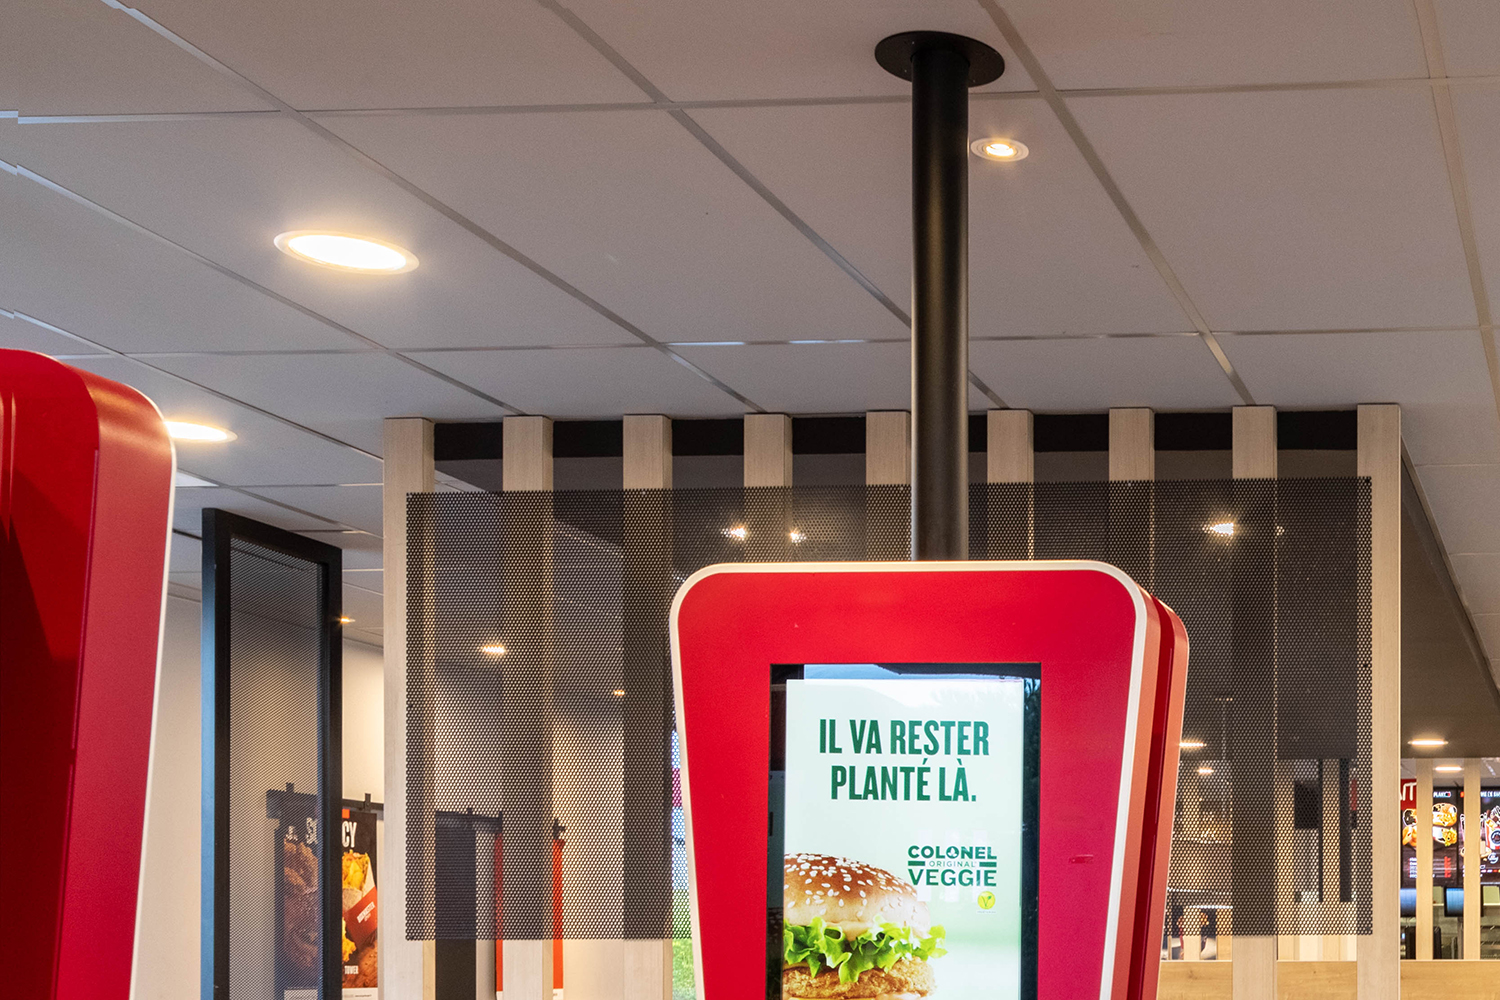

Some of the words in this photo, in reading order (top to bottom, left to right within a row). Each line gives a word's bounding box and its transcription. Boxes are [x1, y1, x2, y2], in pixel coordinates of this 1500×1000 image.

[820, 719, 842, 753] IL
[849, 719, 882, 754] VA
[890, 720, 989, 755] RESTER
[831, 758, 930, 801] PLANTÉ
[939, 758, 976, 802] LÀ.
[908, 845, 997, 859] COLONEL
[908, 869, 996, 886] VEGGIE
